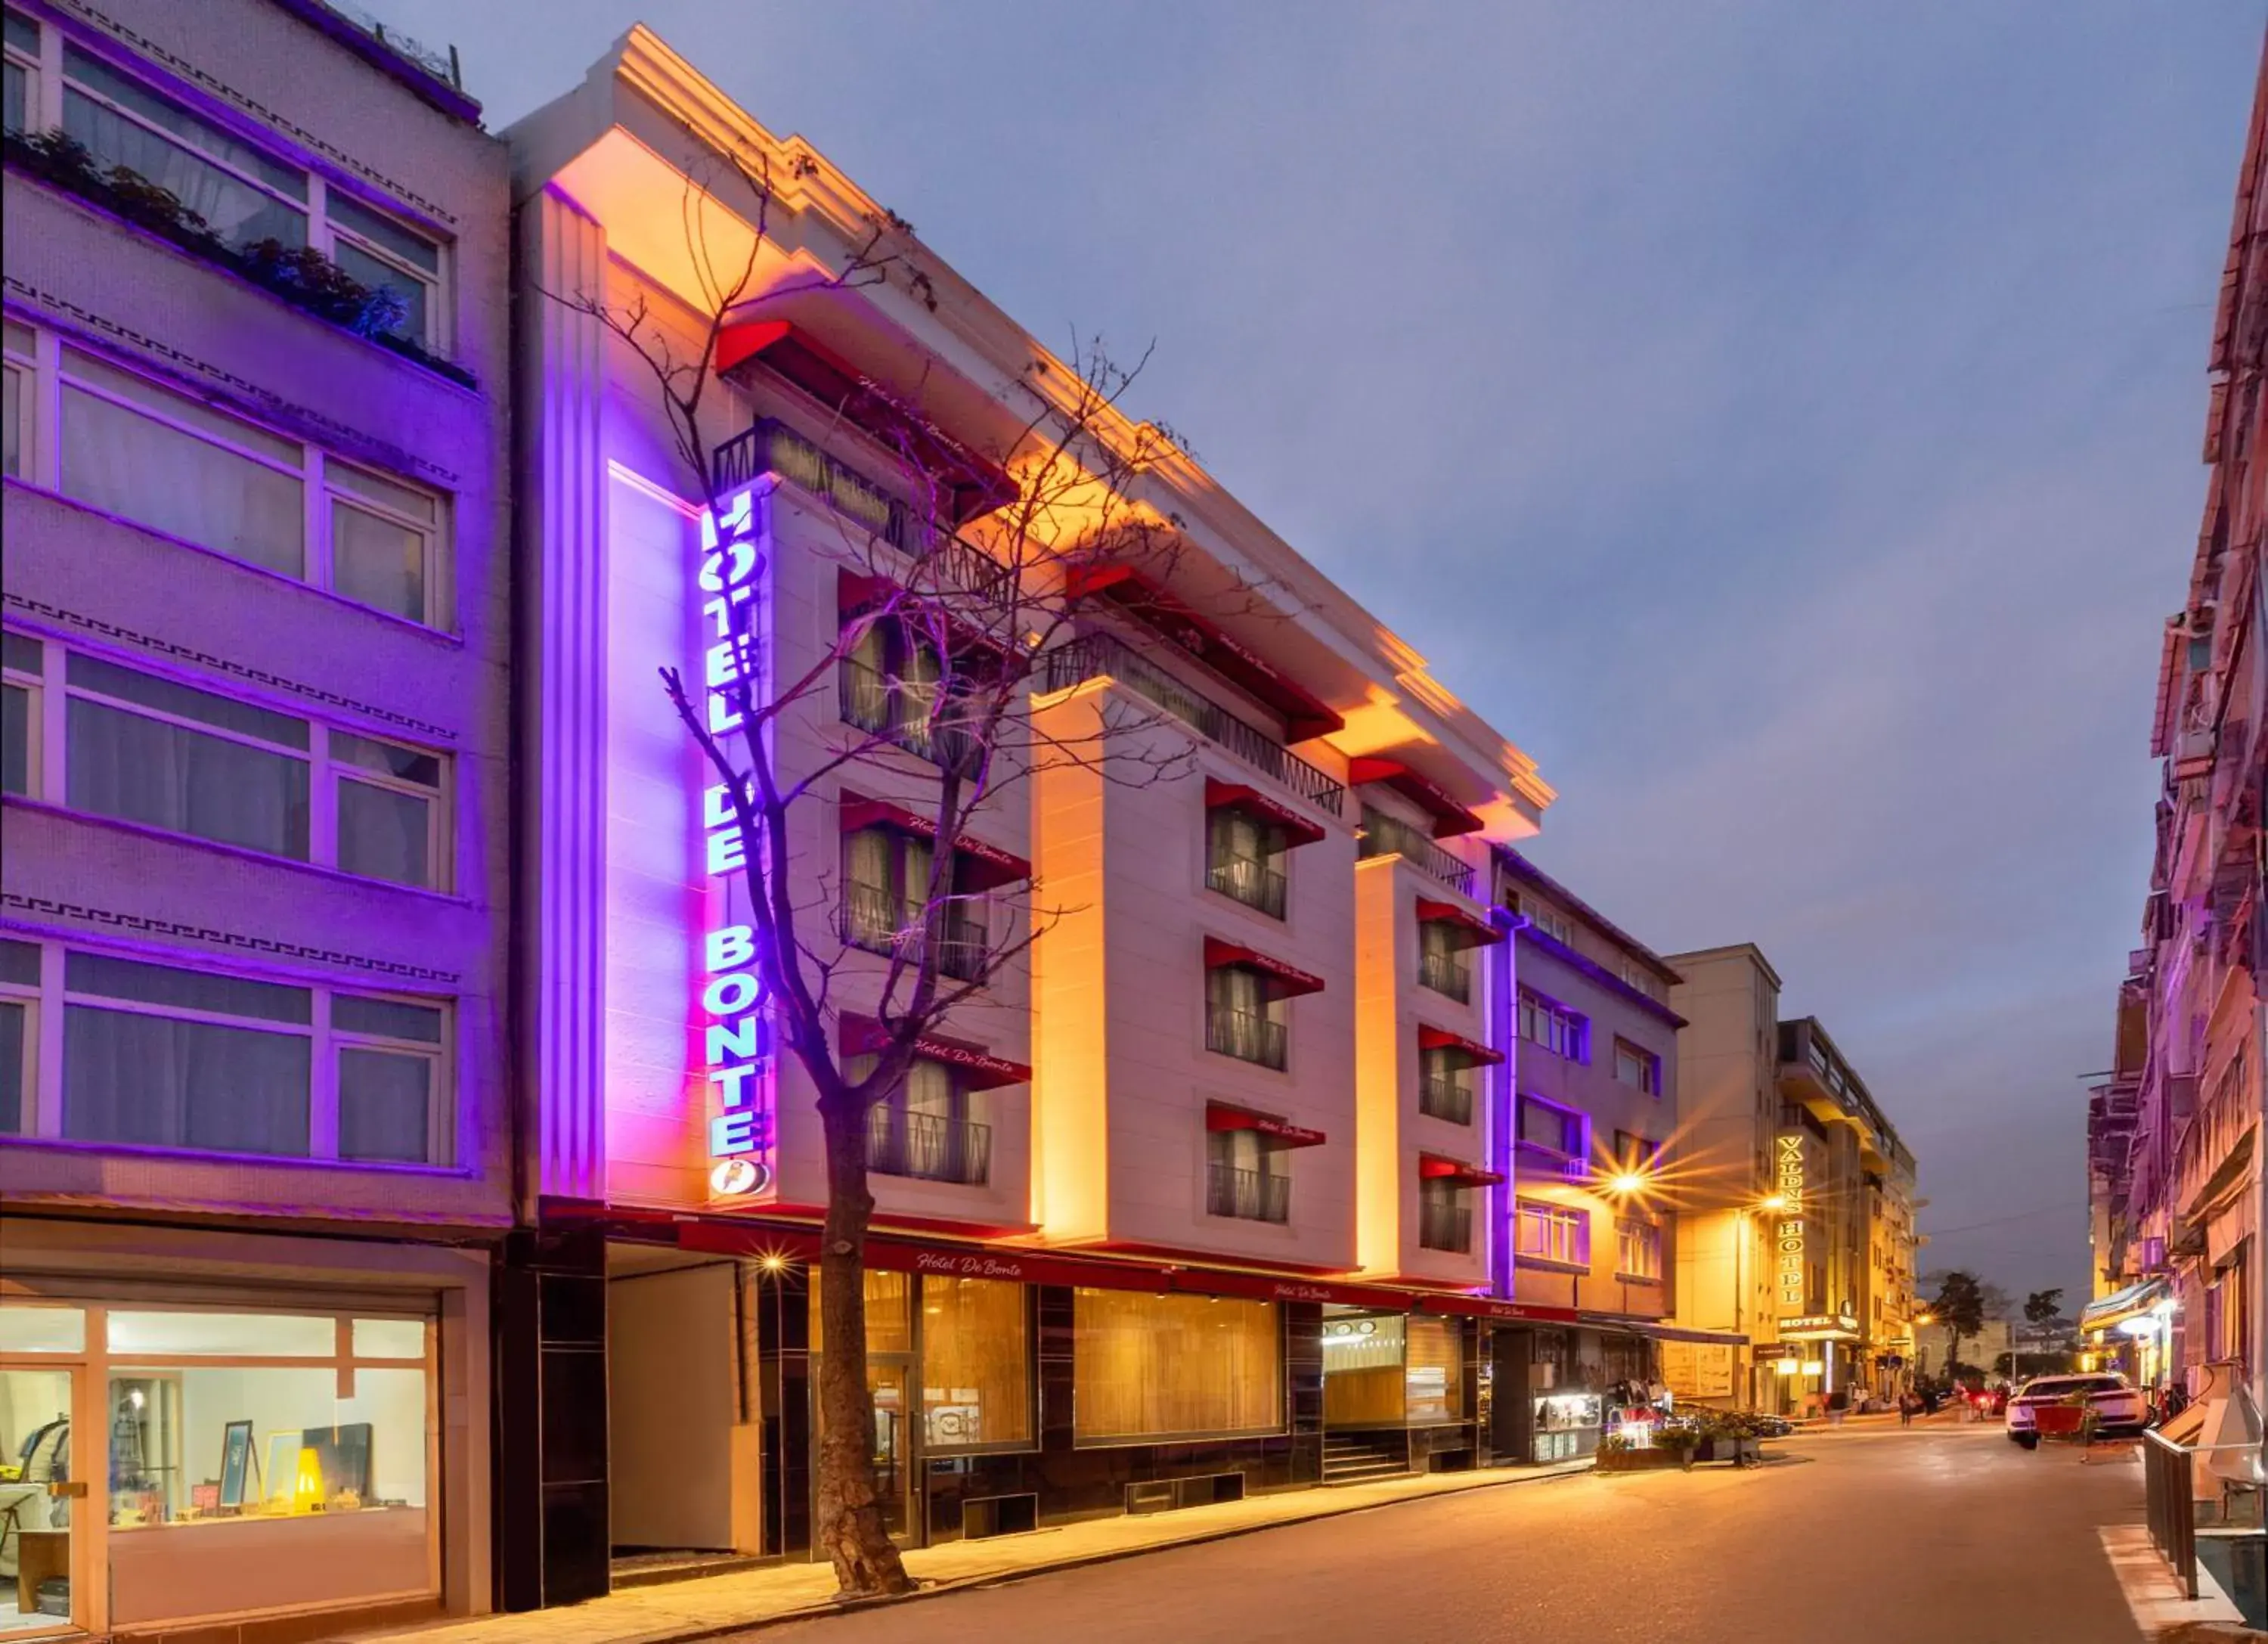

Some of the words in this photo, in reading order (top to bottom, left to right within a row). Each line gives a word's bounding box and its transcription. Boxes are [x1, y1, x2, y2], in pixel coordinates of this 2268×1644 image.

[699, 490, 755, 735] HOTEL
[702, 925, 758, 1158] BONTE
[916, 1252, 957, 1270] Hotel
[961, 1256, 982, 1273] De
[984, 1258, 1023, 1276] Bonte
[1777, 1220, 1803, 1304] HOTEL
[1780, 1316, 1833, 1329] HOTEL
